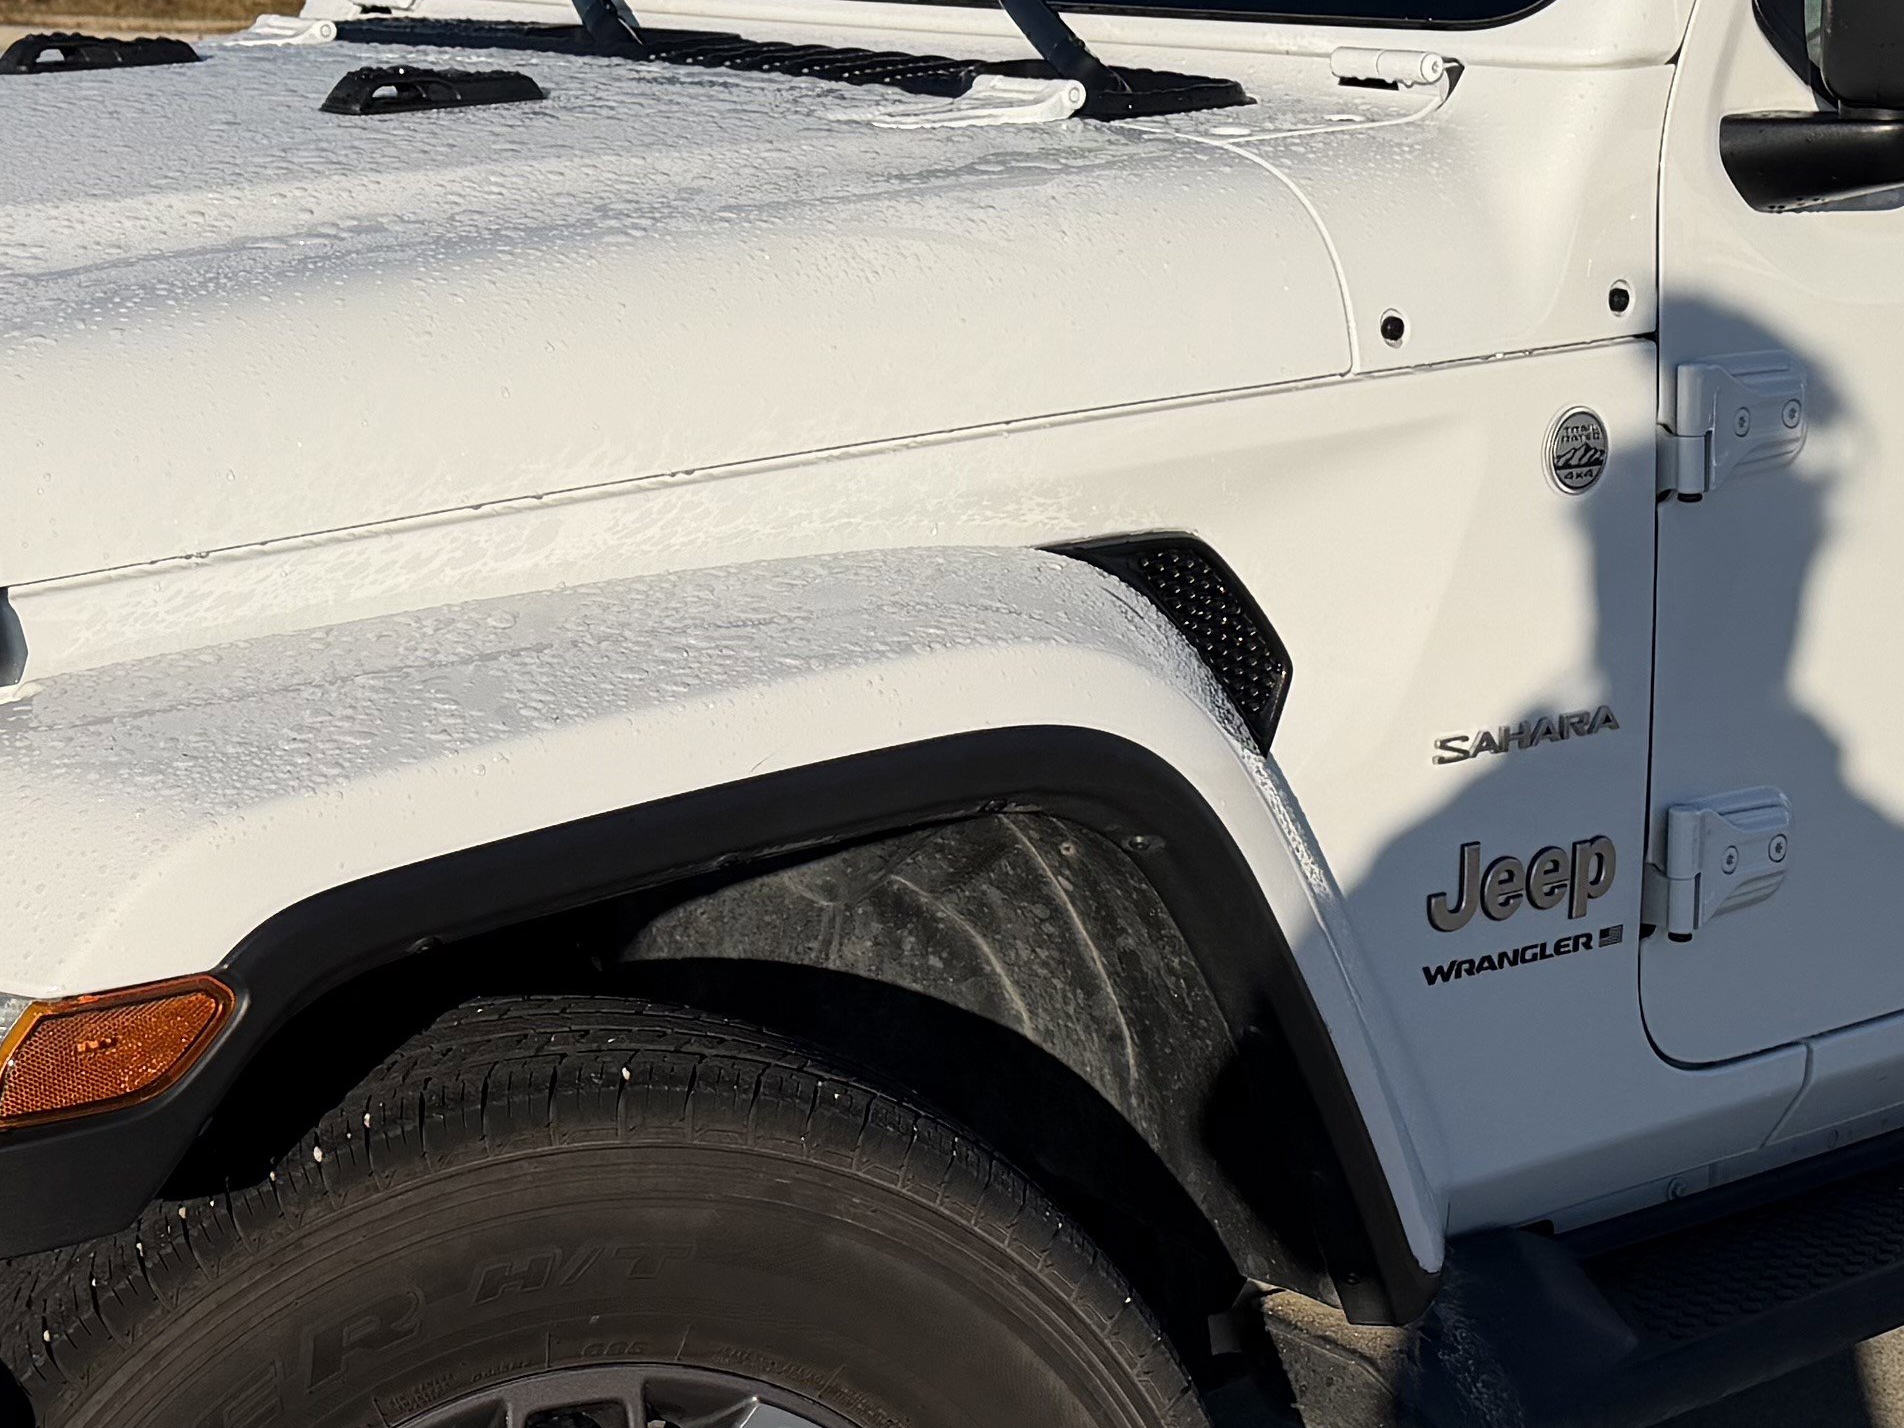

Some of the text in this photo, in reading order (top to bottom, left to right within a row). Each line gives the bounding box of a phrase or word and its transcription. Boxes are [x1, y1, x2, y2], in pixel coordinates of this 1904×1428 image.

[1431, 704, 1621, 765] SAHARA
[1426, 834, 1617, 933] Jeep
[1421, 932, 1594, 986] WRANGLER
[472, 1243, 693, 1307] H/T
